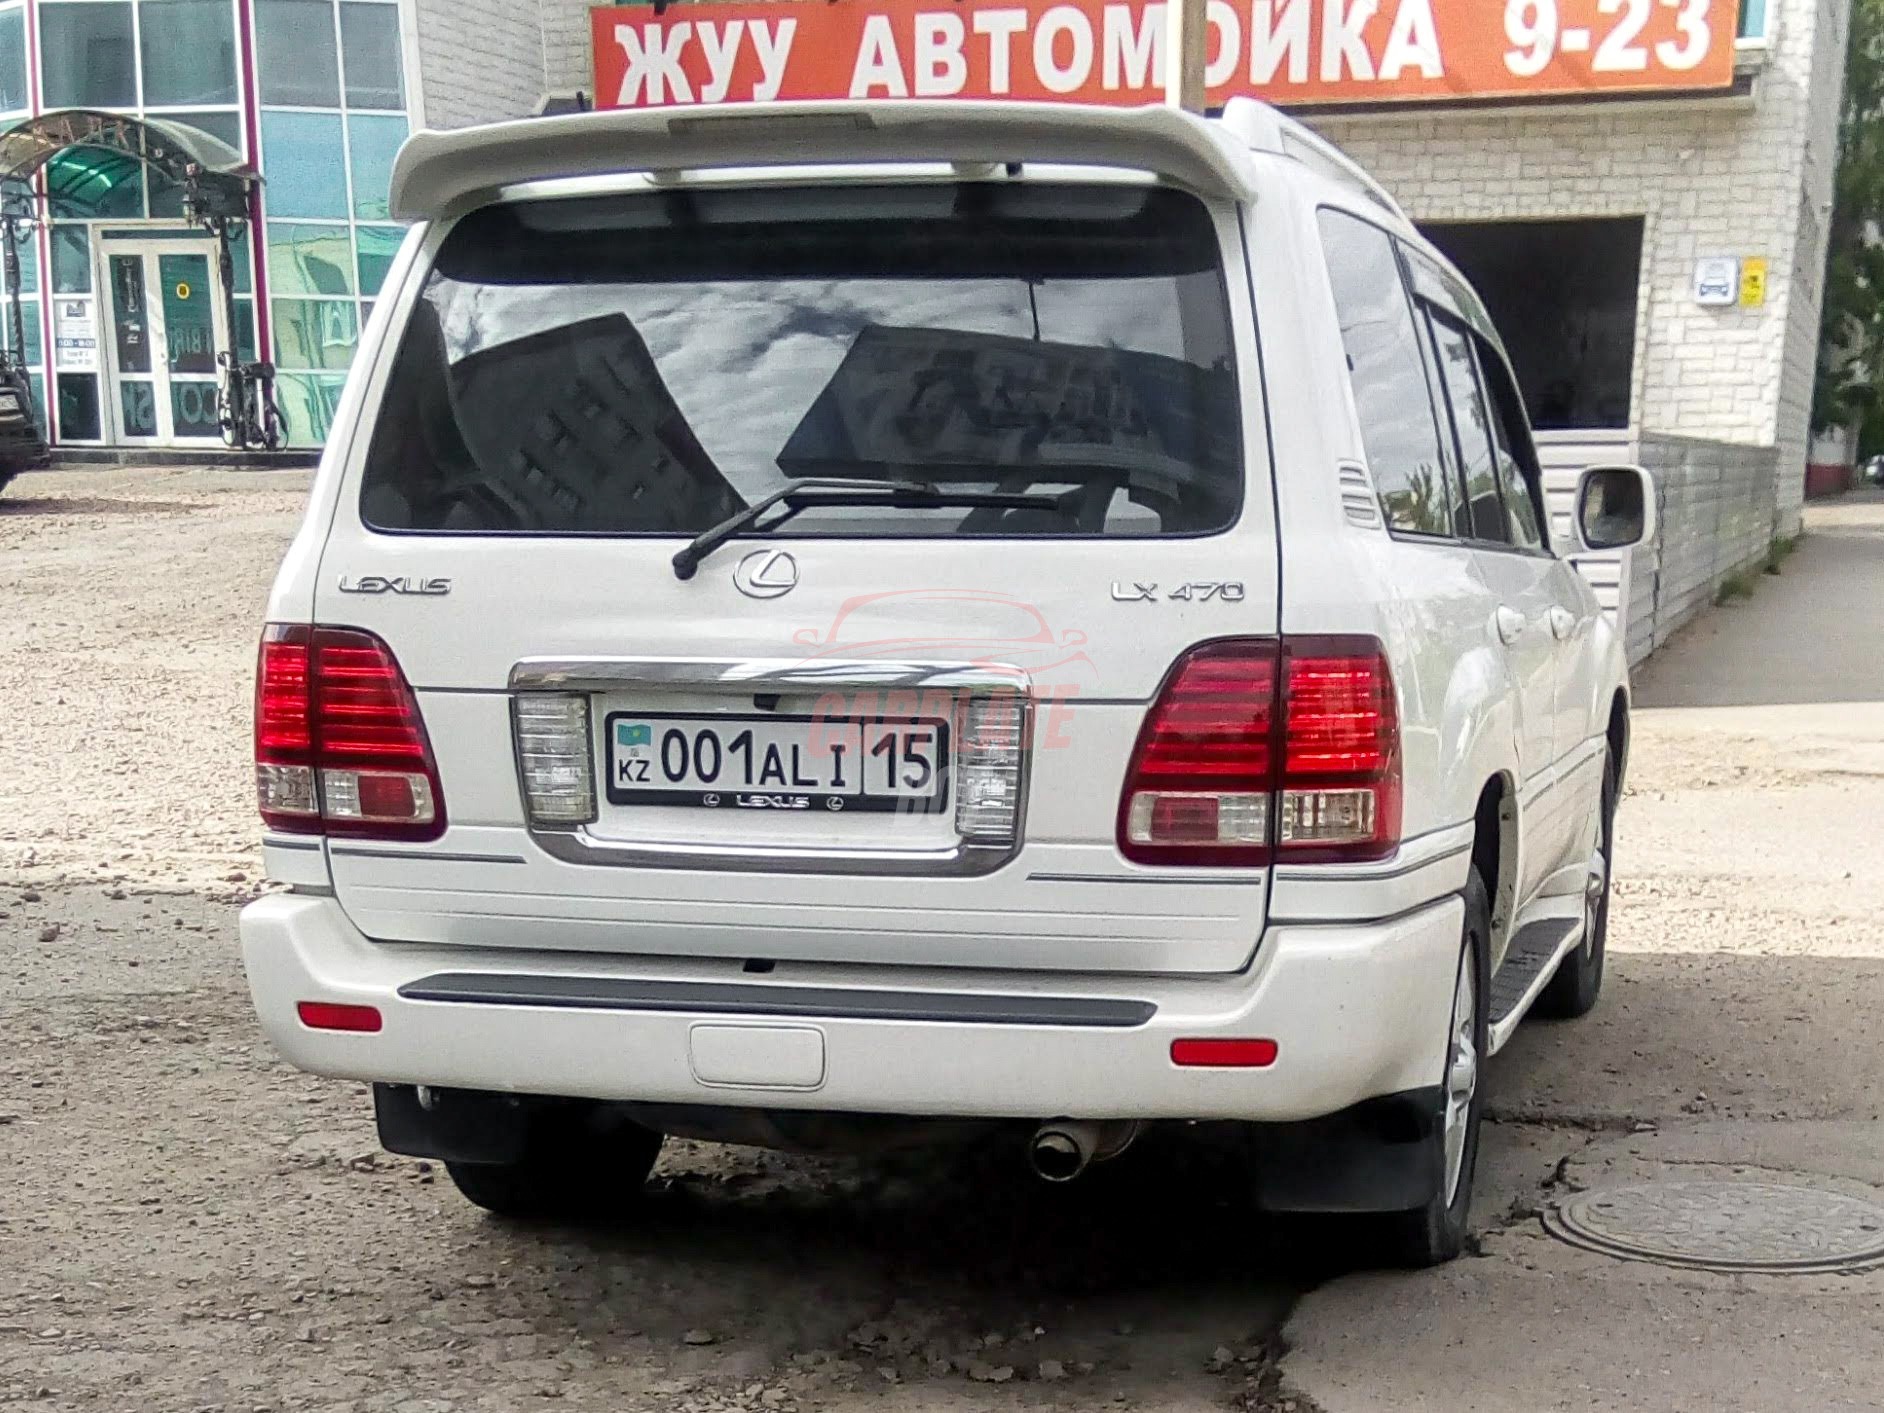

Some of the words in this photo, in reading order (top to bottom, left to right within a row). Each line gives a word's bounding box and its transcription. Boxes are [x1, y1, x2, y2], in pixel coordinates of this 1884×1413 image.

[615, 18, 797, 105] ЖУУ
[1503, 0, 1710, 76] 9-23
[338, 575, 452, 596] LEXUS
[1111, 581, 1159, 602] LX
[1168, 582, 1245, 602] 470
[618, 759, 651, 783] KZ
[872, 732, 934, 789] 15
[736, 793, 811, 811] LEXUS
